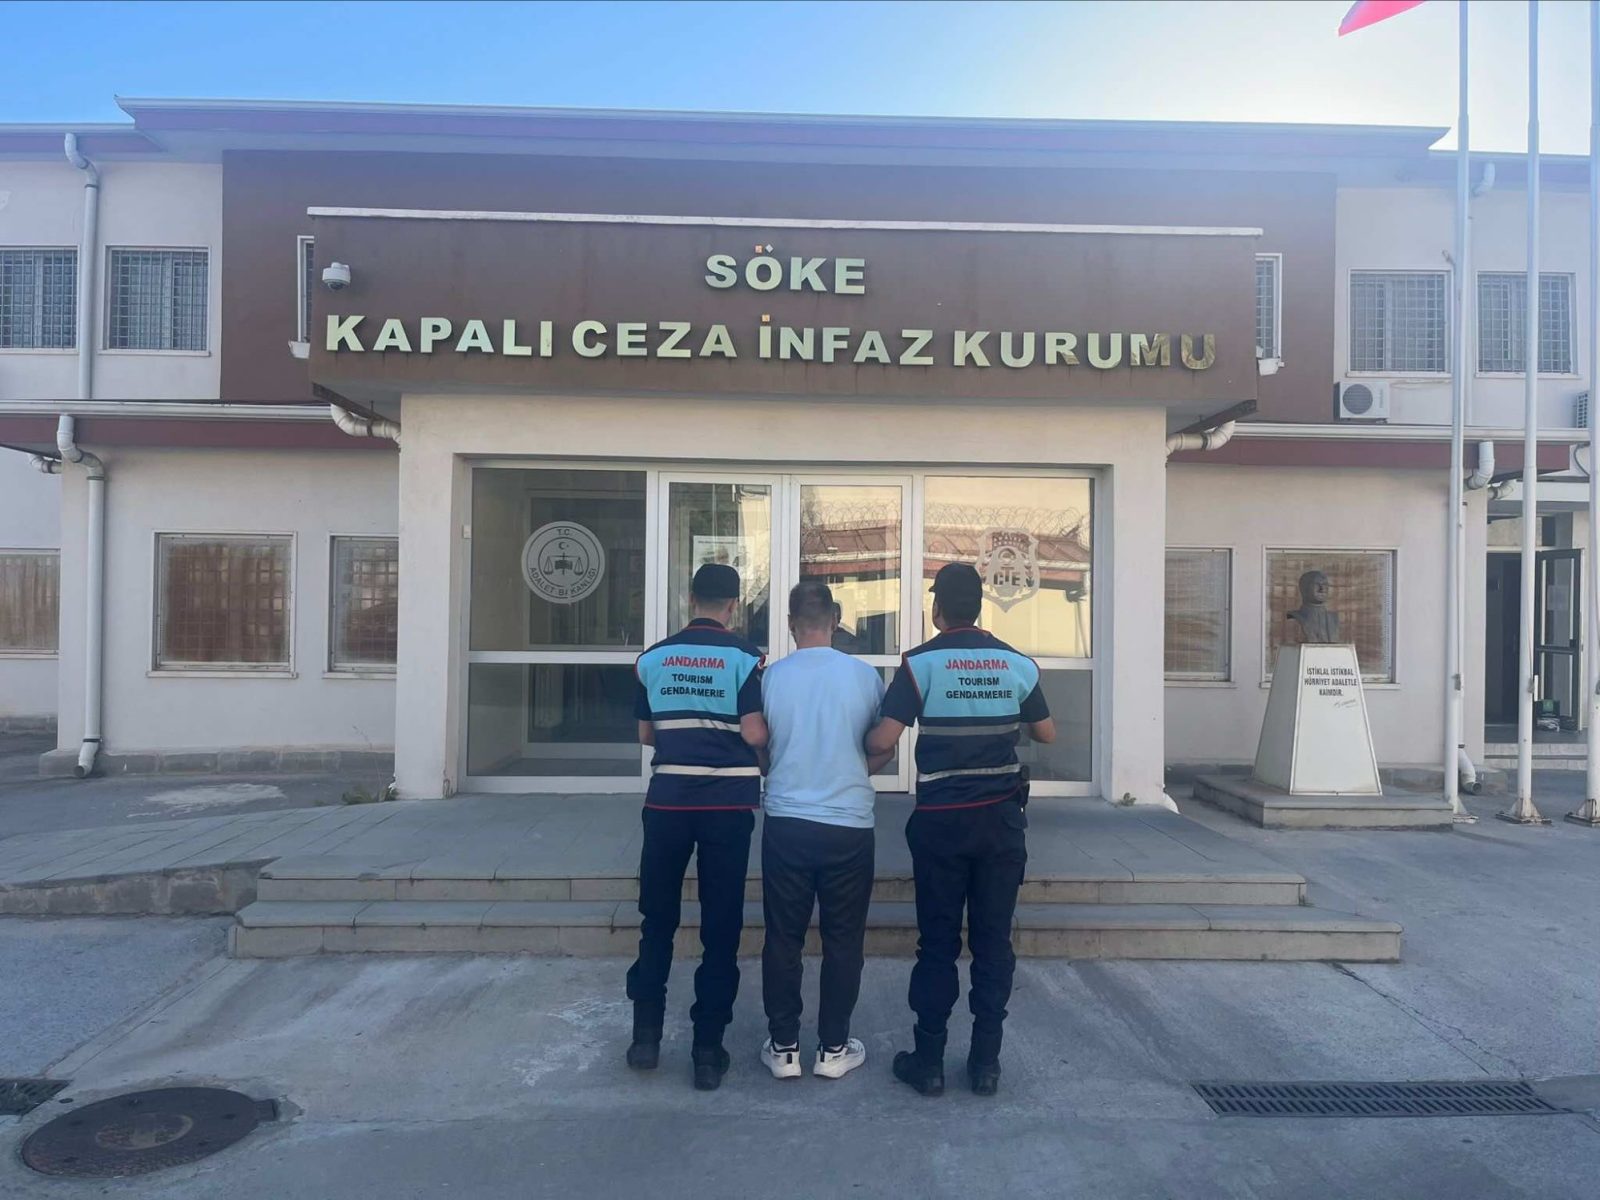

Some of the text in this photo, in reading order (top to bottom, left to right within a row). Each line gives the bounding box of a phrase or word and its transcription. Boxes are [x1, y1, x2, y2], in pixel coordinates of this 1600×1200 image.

[705, 245, 866, 295] SÖKE
[326, 314, 1216, 370] KAPALI CEZA İNFAZ KURUMU
[662, 656, 725, 669] JANDARMA
[945, 659, 1009, 671] JANDARMA
[672, 673, 713, 684] TOURISM
[958, 677, 1000, 686] TOURISM
[660, 686, 725, 698] GENDARMERIE
[946, 690, 1012, 699] GENDARMERIE
